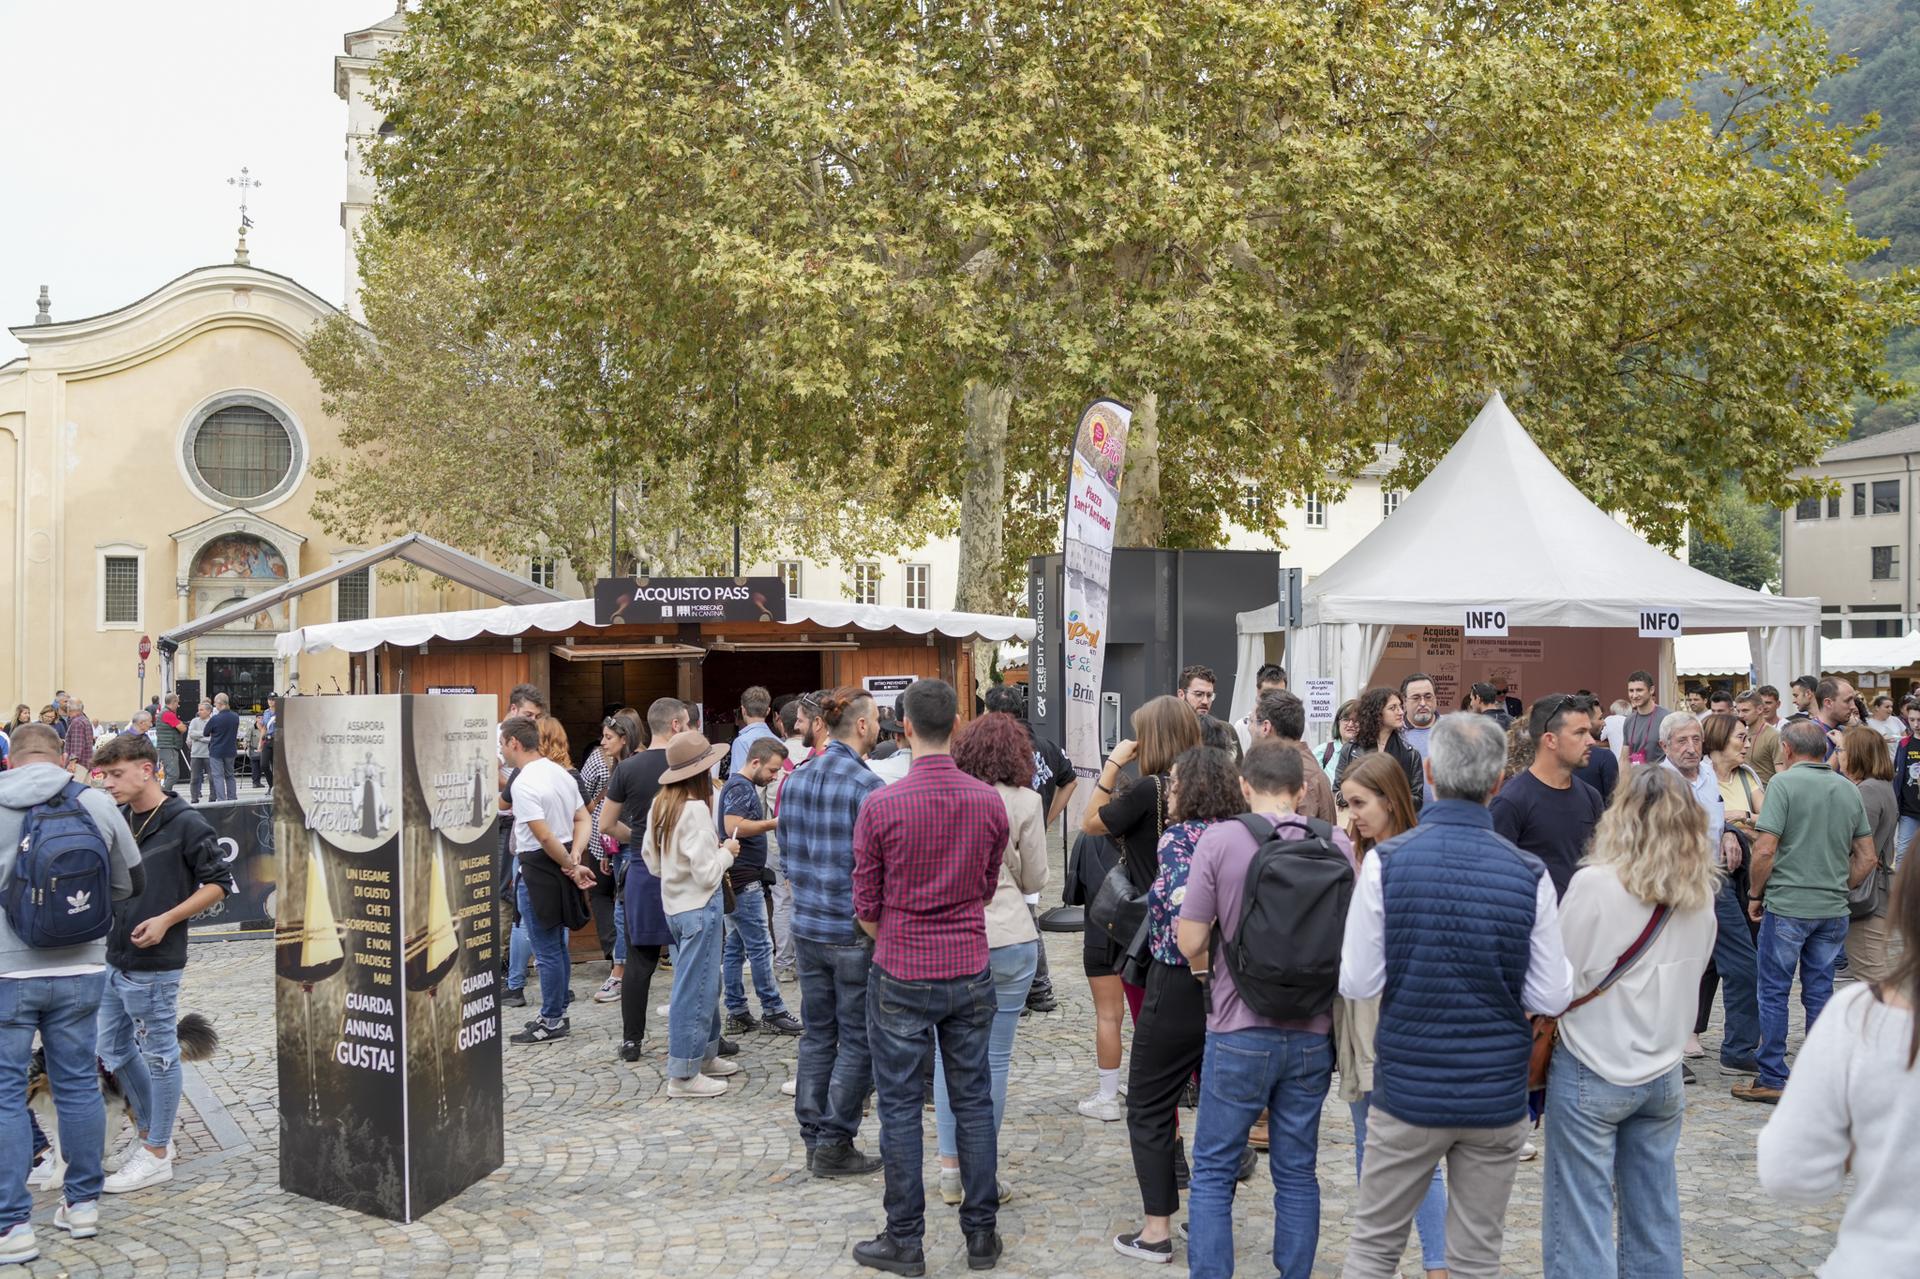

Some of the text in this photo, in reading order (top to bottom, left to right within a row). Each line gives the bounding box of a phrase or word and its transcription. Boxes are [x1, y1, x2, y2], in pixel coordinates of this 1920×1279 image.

[1086, 485, 1102, 508] Piazza
[1074, 495, 1111, 531] Sant'Antonio
[634, 587, 750, 602] ACQUISTO PASS
[1037, 577, 1045, 643] AGRICOLE
[1466, 611, 1506, 629] INFO
[1640, 612, 1680, 631] INFO
[1423, 626, 1459, 637] Acquista
[139, 642, 151, 652] STOP
[1036, 645, 1045, 692] CRÉDIT
[1428, 673, 1454, 682] cquista
[347, 721, 385, 731] ASSAPORA
[346, 735, 385, 744] FORMAGGI
[313, 789, 353, 802] SOCIALE
[468, 854, 491, 869] LEGAME
[346, 868, 390, 883] UN LEGAME
[464, 871, 491, 886] DI GUSTO
[354, 886, 390, 900] DI GUSTO
[67, 904, 91, 914] adidas
[366, 904, 391, 917] CHE TI
[458, 901, 492, 918] SORPRENDE
[345, 918, 391, 934] SORPRENDE
[478, 917, 491, 929] NON
[366, 937, 391, 951] E NON
[465, 932, 492, 949] TRADISCE
[354, 952, 392, 968] TRADISCE
[461, 970, 494, 996] GUARDA
[345, 992, 394, 1016] GUARDA
[462, 994, 495, 1021] ANNUSA
[344, 1018, 395, 1042] ANNUSA
[458, 1015, 497, 1051] GUSTA!
[336, 1041, 395, 1074] GUSTA!
